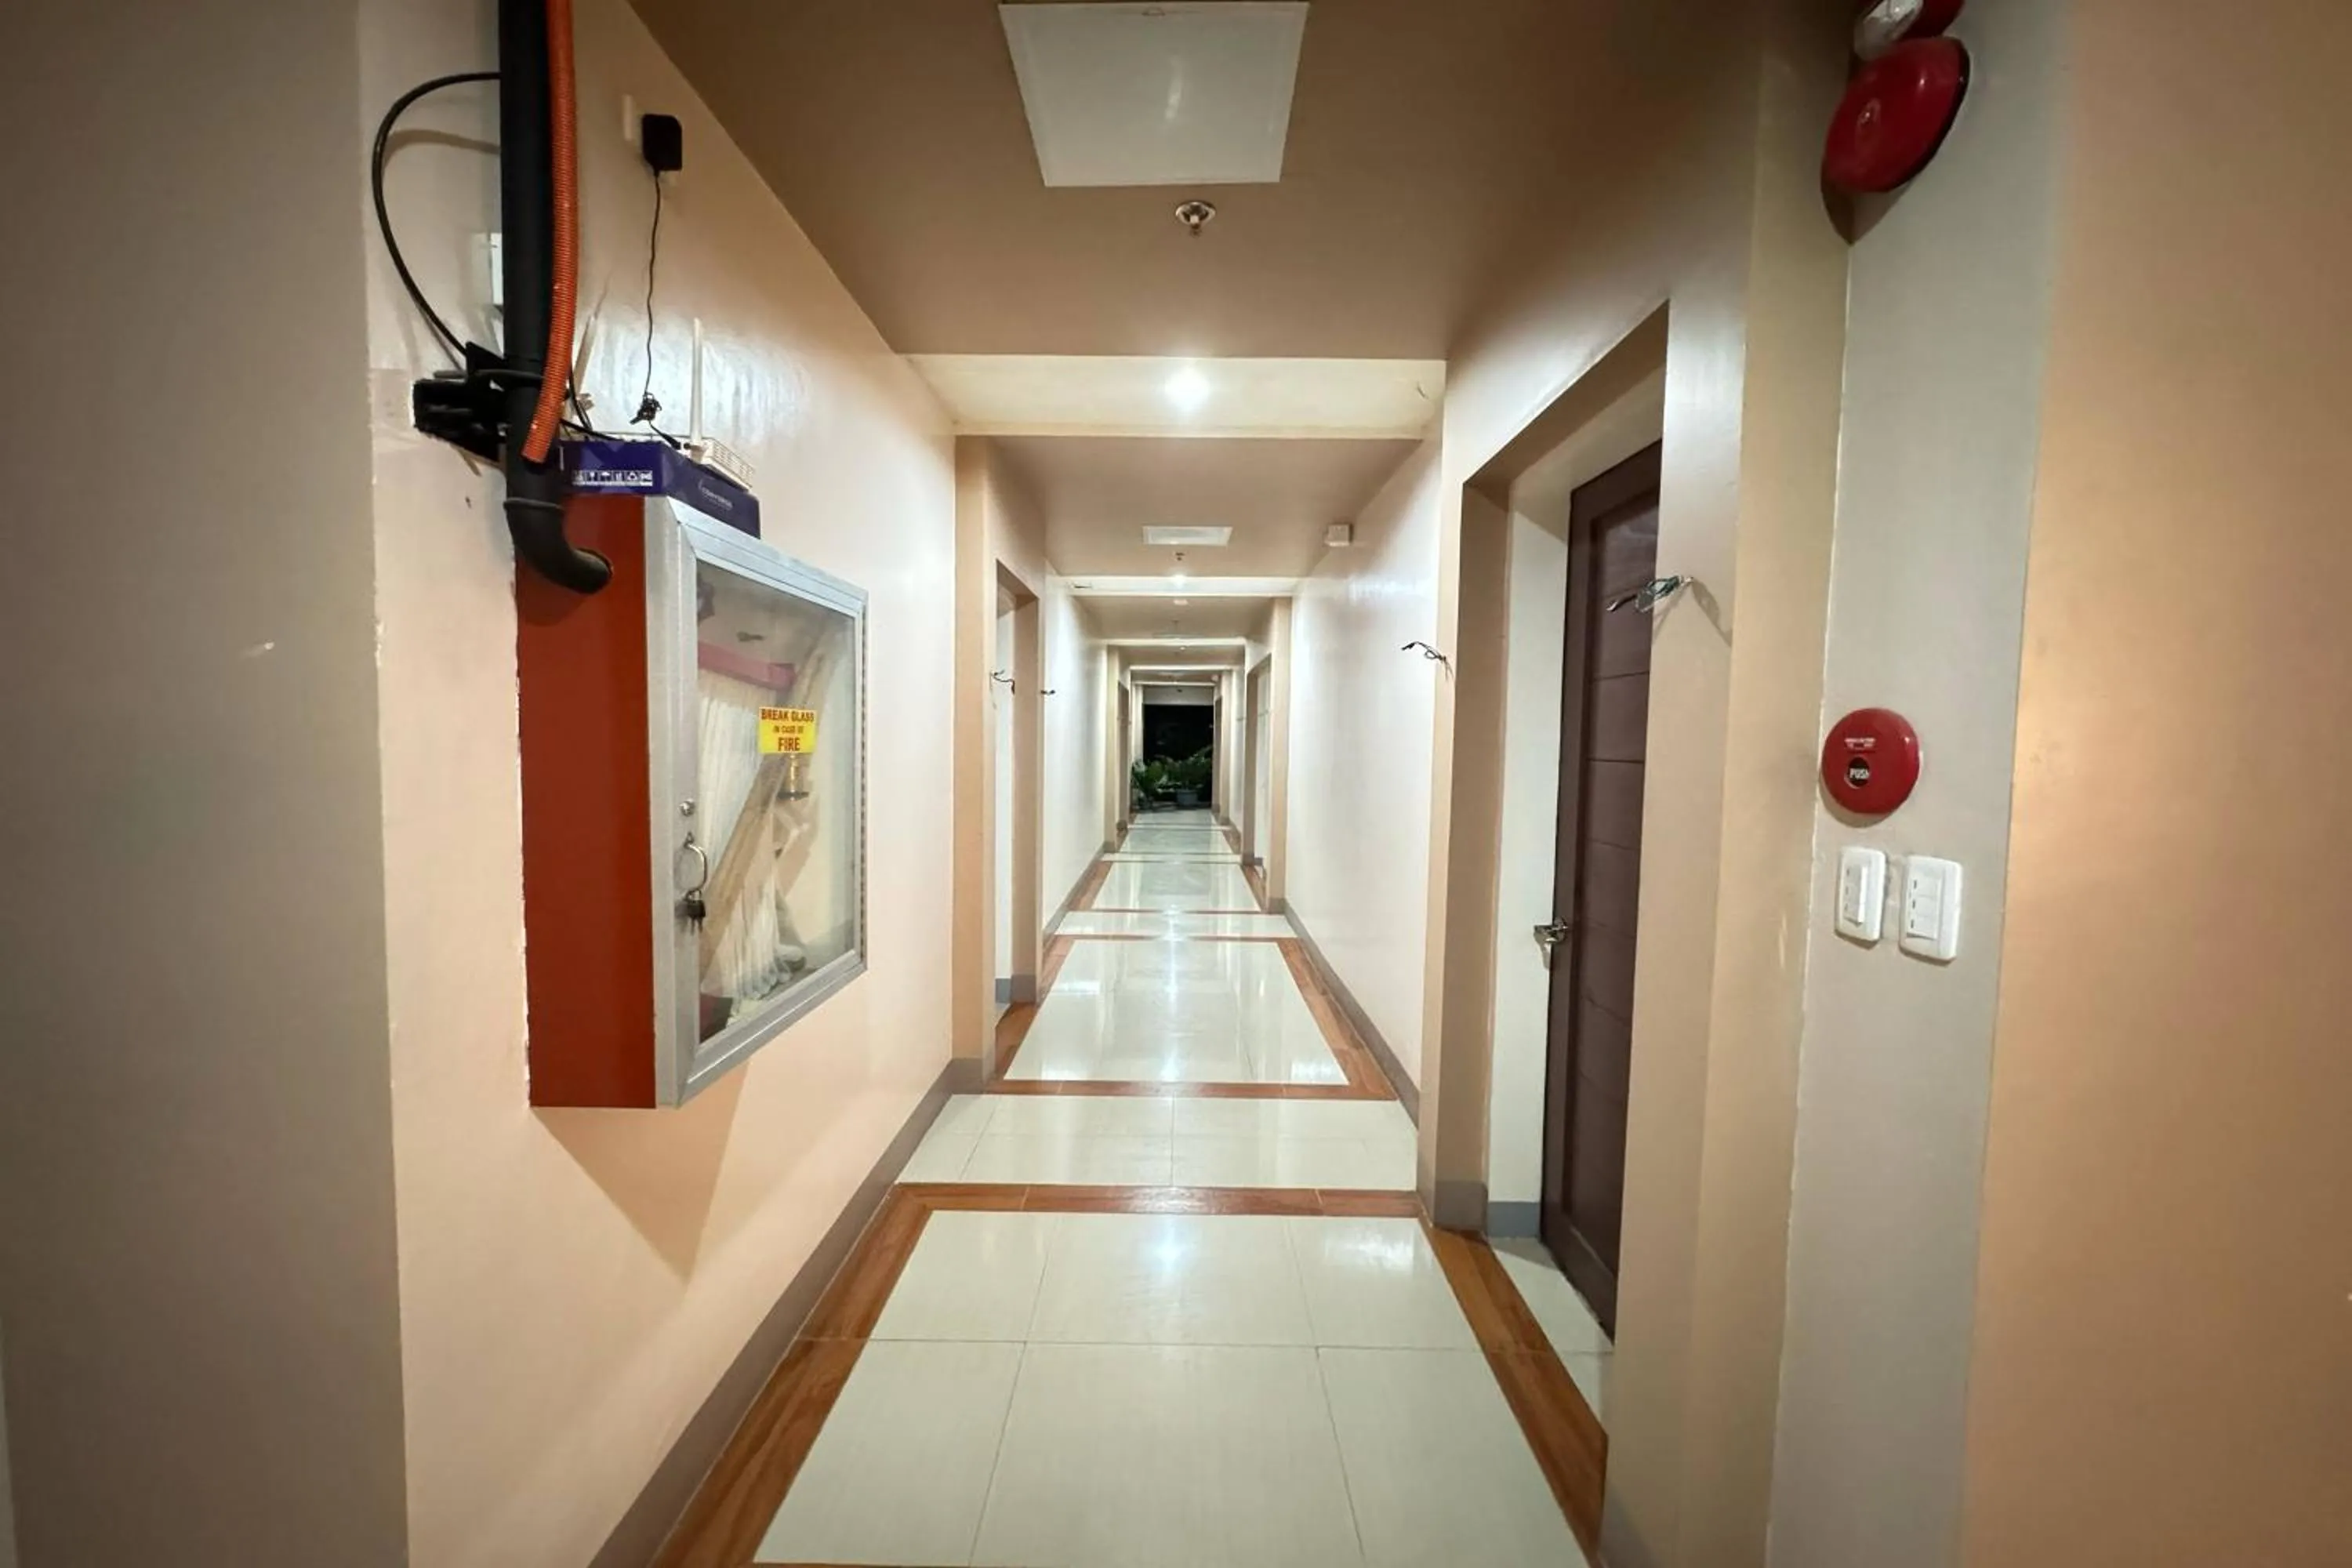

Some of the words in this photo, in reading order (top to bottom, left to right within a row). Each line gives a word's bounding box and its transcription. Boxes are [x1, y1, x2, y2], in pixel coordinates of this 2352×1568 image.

[761, 709, 789, 720] BREAK
[791, 710, 815, 722] GLASS
[778, 737, 800, 751] FIRE
